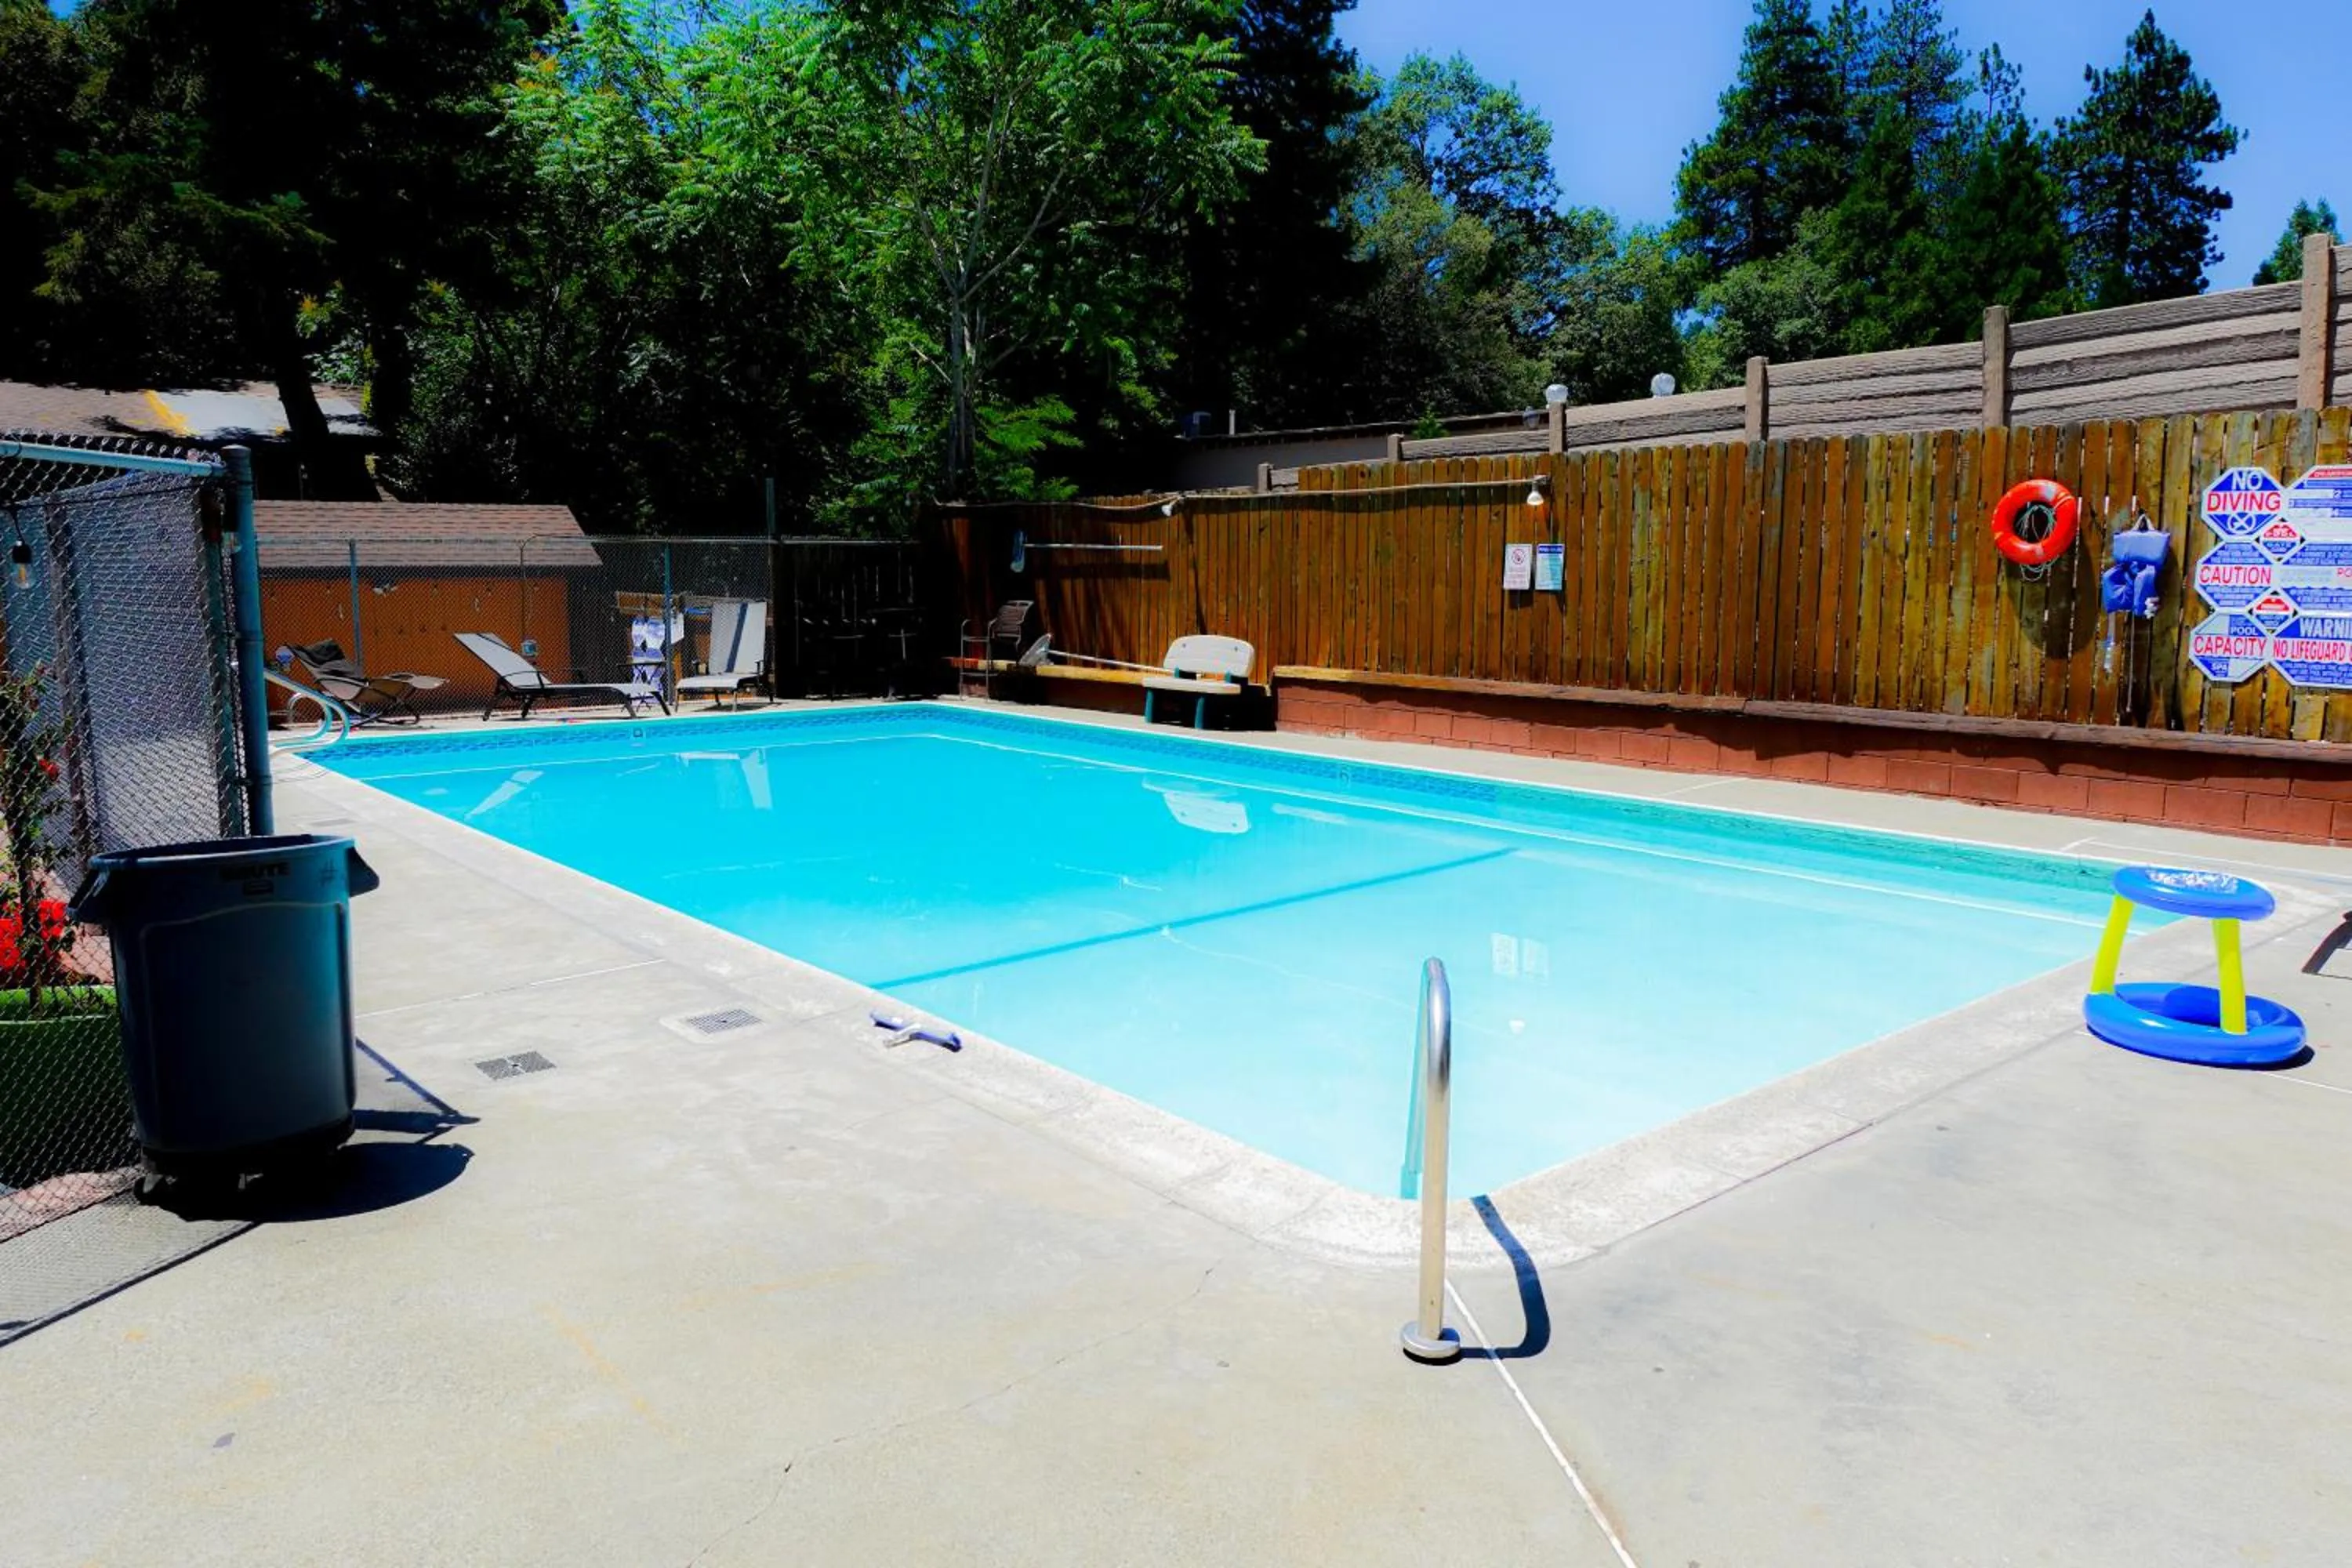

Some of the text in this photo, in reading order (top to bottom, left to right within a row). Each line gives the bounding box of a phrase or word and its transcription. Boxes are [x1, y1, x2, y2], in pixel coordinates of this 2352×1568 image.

[2232, 470, 2263, 490] NO
[2207, 492, 2281, 511] DIVING
[2199, 566, 2271, 584] CAUTION
[2194, 636, 2267, 655] CAPACITY
[2274, 639, 2288, 658] NO
[2291, 640, 2346, 661] LIFEGUARD
